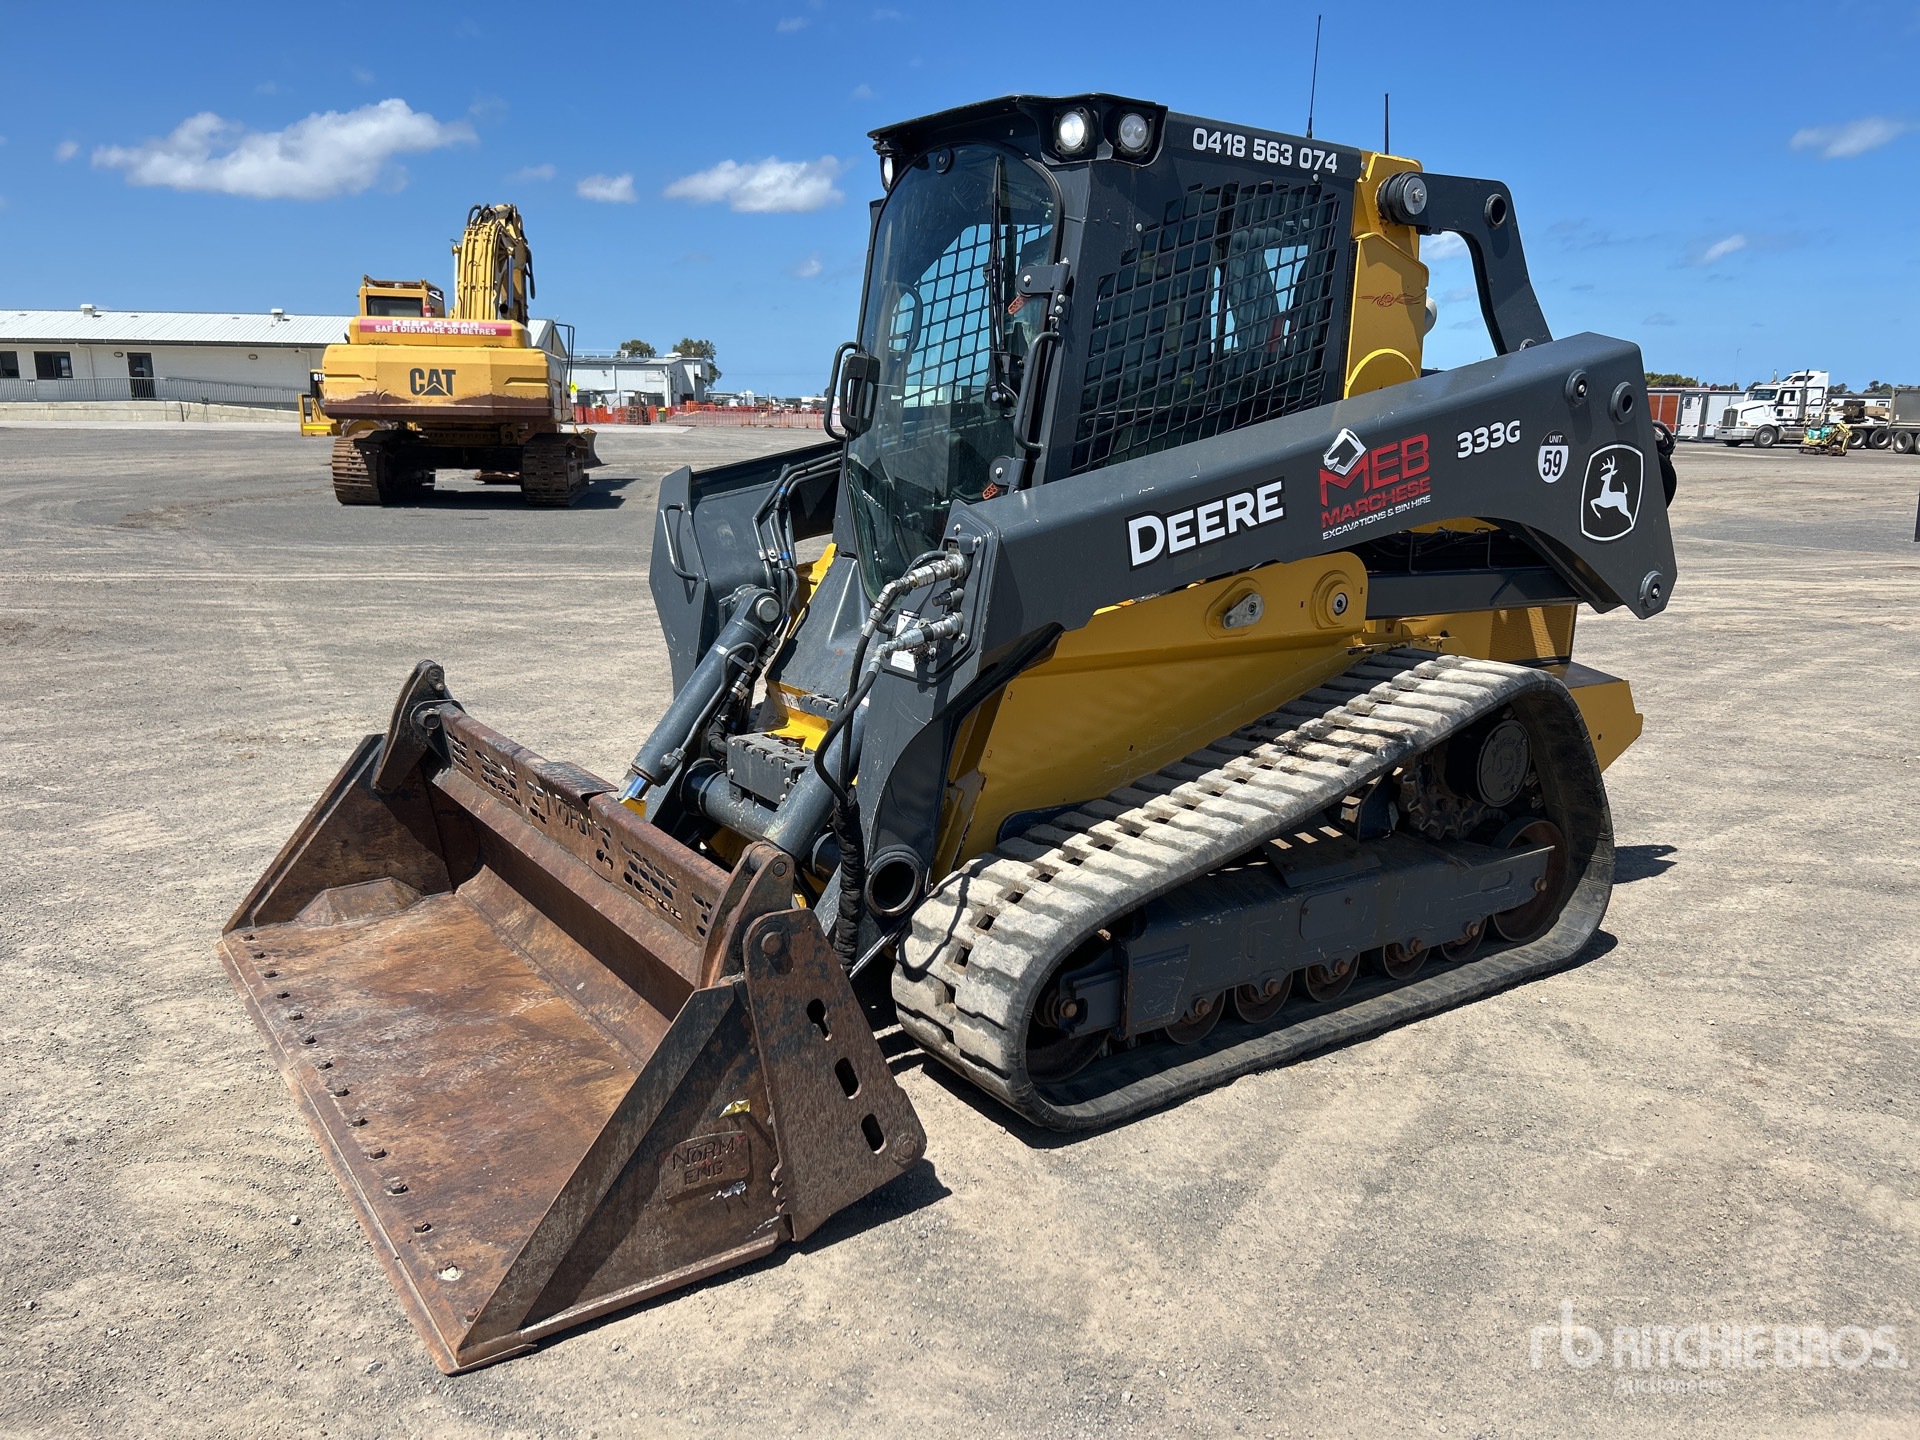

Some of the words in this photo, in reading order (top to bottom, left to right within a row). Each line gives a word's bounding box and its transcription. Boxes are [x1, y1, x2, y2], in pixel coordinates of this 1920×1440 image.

[1192, 127, 1246, 158] 0418
[1252, 138, 1293, 166] 563
[1298, 147, 1338, 174] 074
[375, 325, 398, 333] SAFE
[400, 325, 445, 334] DISTANCE
[447, 327, 459, 335] 30
[460, 327, 497, 336] METRES
[391, 319, 430, 328] KEEP
[433, 320, 480, 329] CLEAR
[409, 367, 457, 396] CAT
[1457, 420, 1521, 459] 333G
[1548, 435, 1563, 444] UNIT
[1319, 432, 1430, 507] MEB
[1542, 449, 1563, 477] 59
[1321, 477, 1431, 529] MARCHESE
[1322, 510, 1387, 540] EXCAVATIONS
[1387, 507, 1395, 517] &
[1395, 501, 1411, 514] BIN
[1410, 495, 1431, 509] HIRE
[1128, 480, 1284, 567] DEERE
[684, 1160, 723, 1186] ENG
